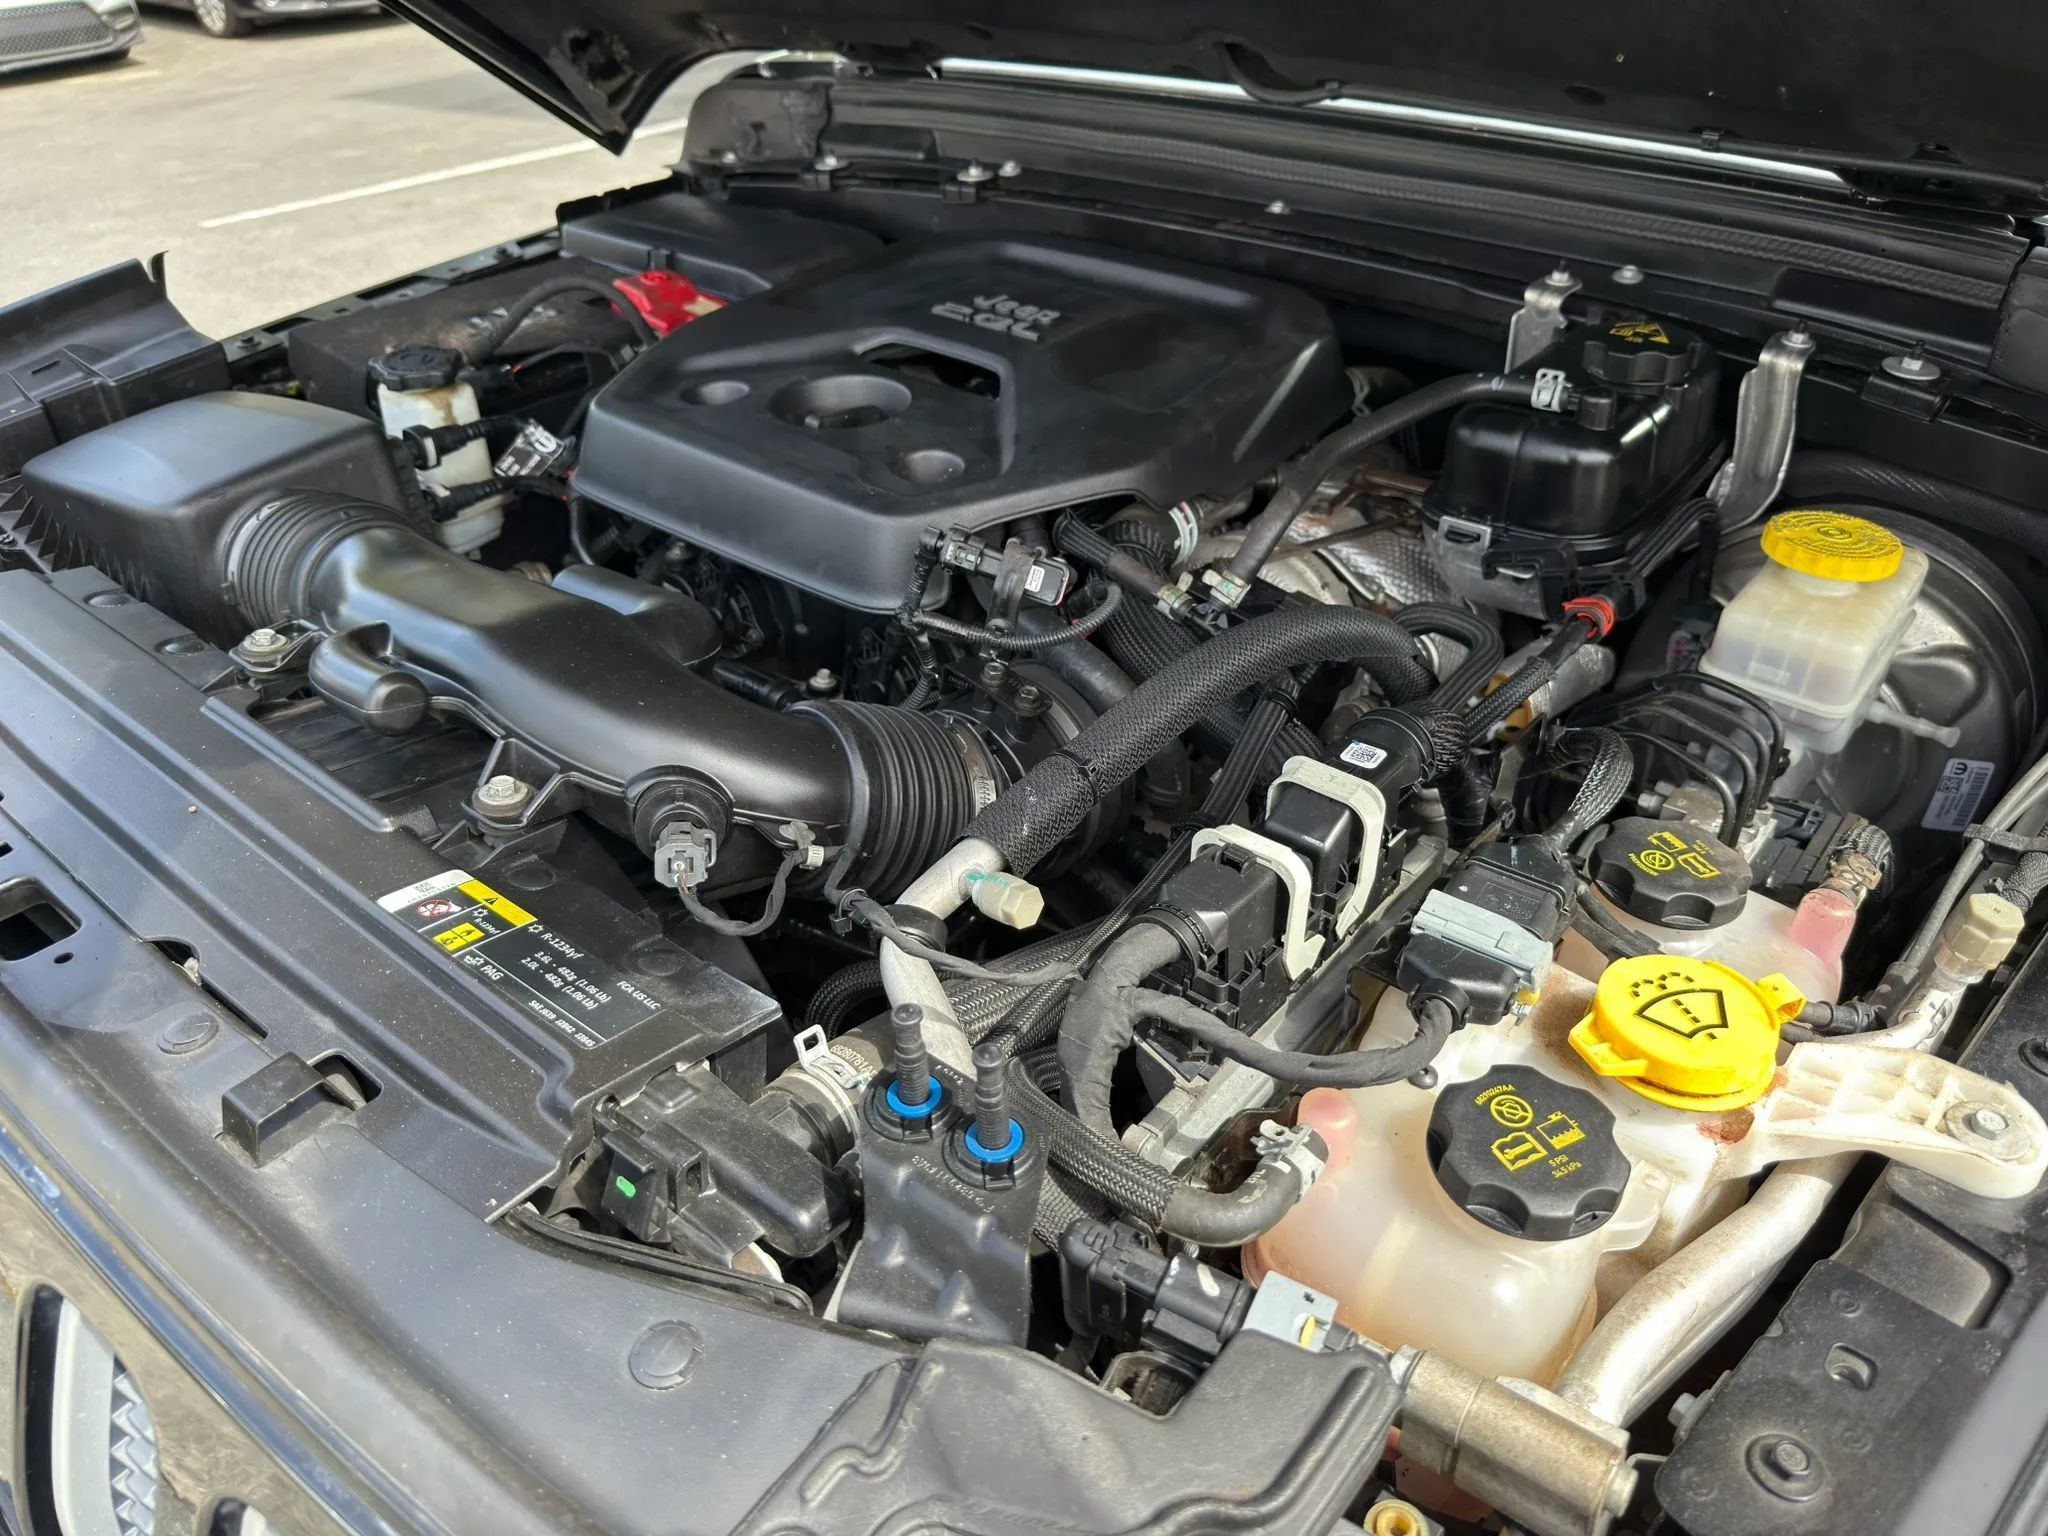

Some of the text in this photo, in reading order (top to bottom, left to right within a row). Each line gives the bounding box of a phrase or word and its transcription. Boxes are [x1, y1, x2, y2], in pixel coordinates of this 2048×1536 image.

[973, 294, 1060, 326] Jeep
[540, 932, 585, 960] R-1234yf
[480, 964, 504, 981] PAG
[520, 956, 540, 970] 2.0L
[561, 985, 587, 1001] (1.06
[581, 997, 599, 1010] Lb)
[534, 951, 553, 964] 3.6L
[574, 978, 600, 994] (1.06
[528, 1000, 545, 1011] SAE
[616, 980, 661, 1010] FCA US LLC
[830, 1044, 879, 1079] 68280781A
[1553, 1153, 1569, 1165] PSI
[1565, 1161, 1583, 1172] kPa
